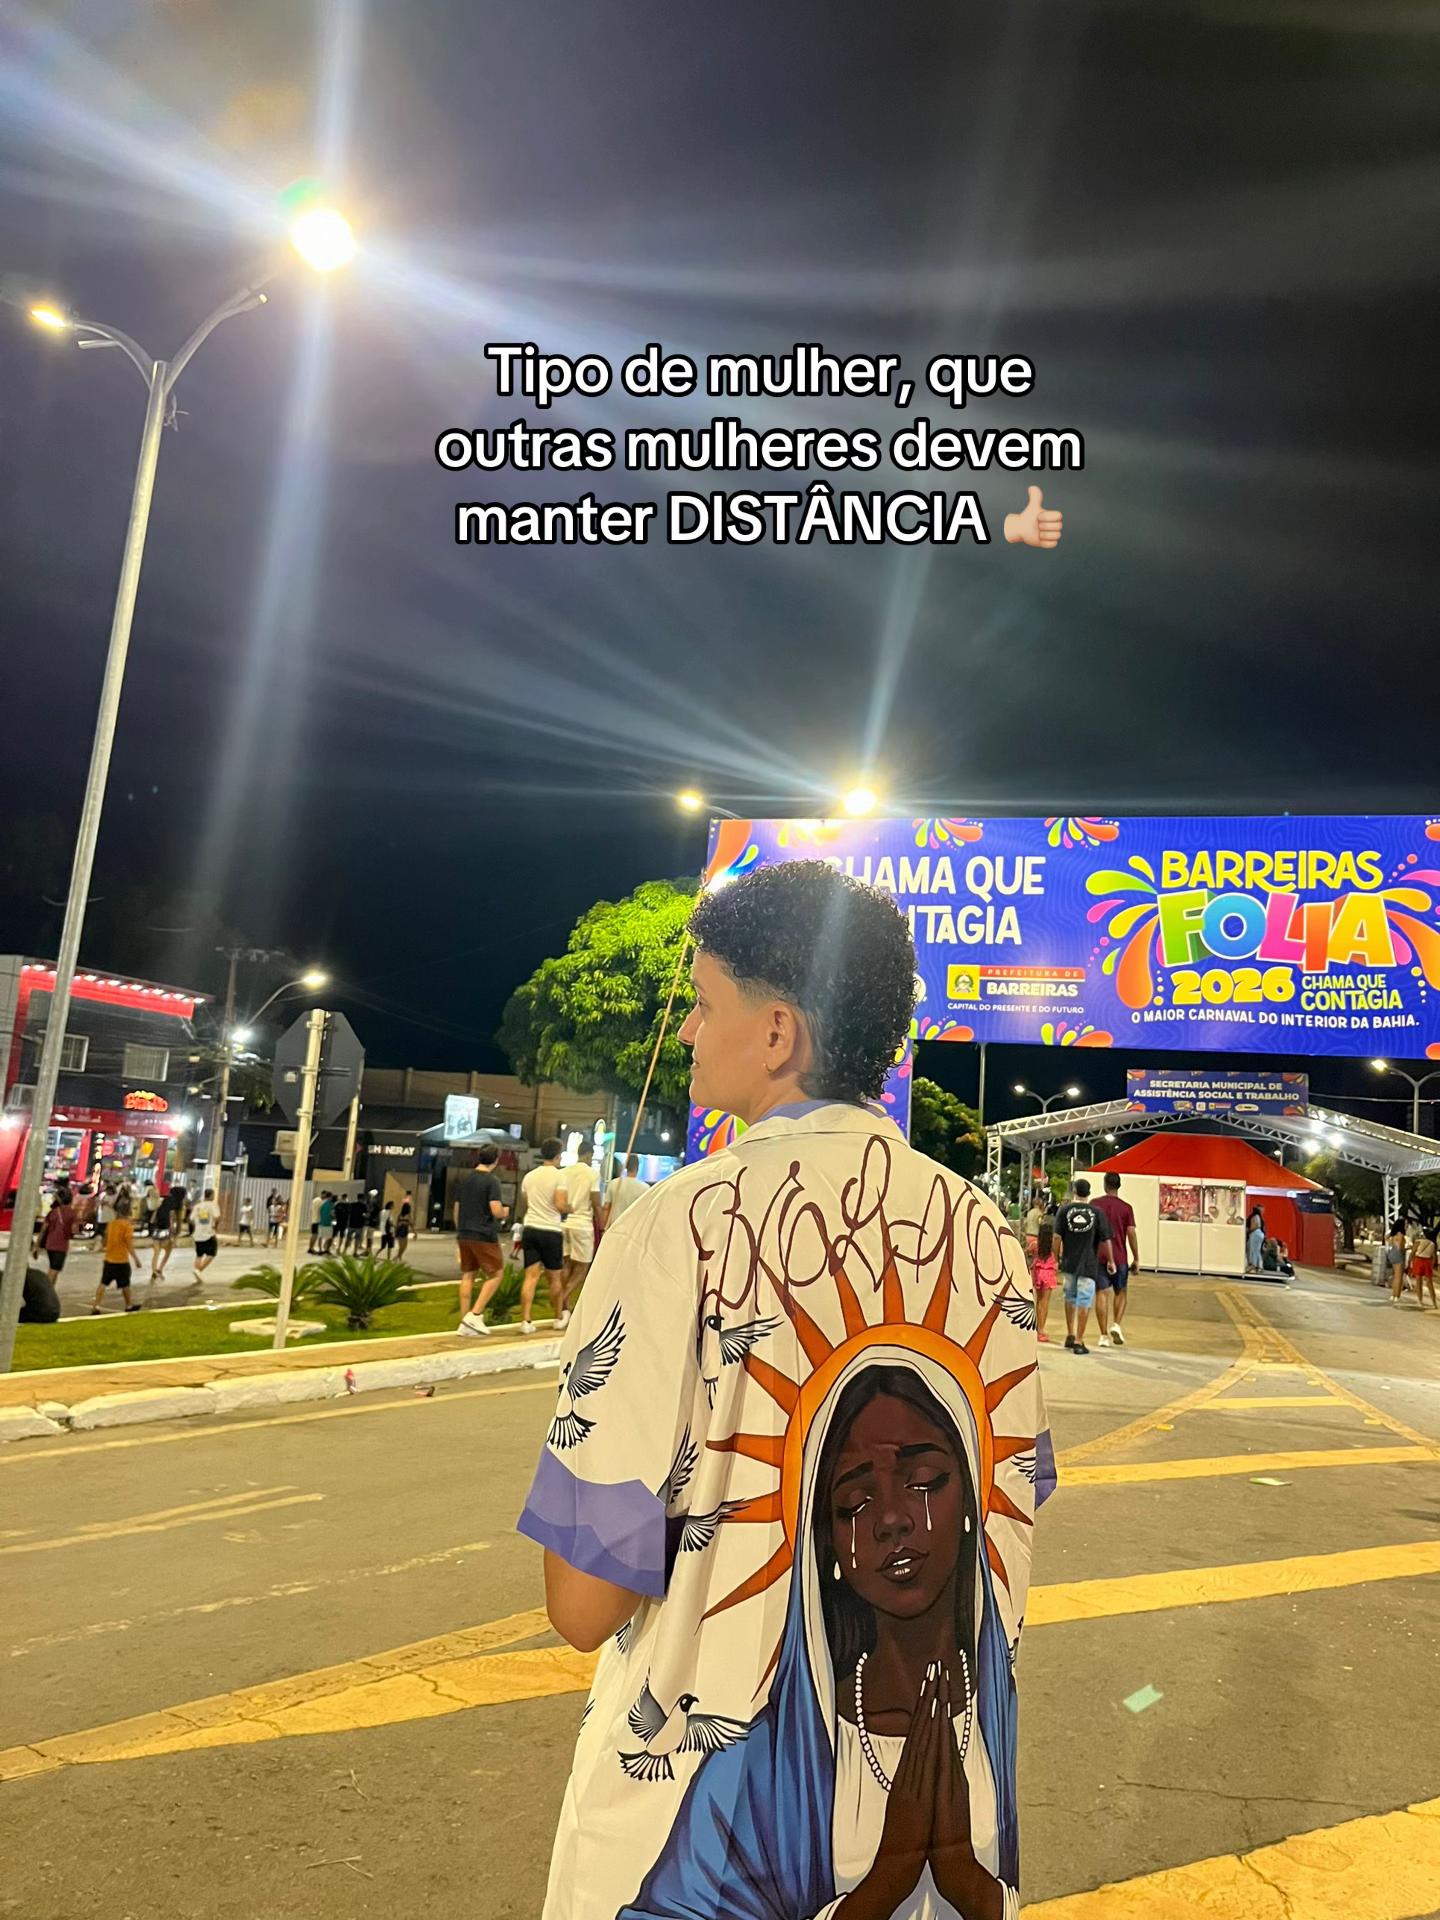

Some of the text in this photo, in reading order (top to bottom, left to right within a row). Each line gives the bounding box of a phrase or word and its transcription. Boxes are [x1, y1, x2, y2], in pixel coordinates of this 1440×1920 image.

[964, 855, 1047, 904] QUE
[1161, 849, 1385, 894] BARREIRAS
[1157, 887, 1398, 974] FOLIA
[987, 968, 1079, 978] PREFEITURA DE
[1301, 973, 1387, 991] CHAMA QUE
[986, 981, 1079, 997] BARREIRAS
[1170, 966, 1296, 1005] 2026
[947, 1002, 1085, 1014] CAPITAL DO PRESENTE E DO FUTURO
[1300, 988, 1404, 1012] CONTAGIA
[1131, 1008, 1420, 1029] O MAIOR CARNAVAL DO INTERIOR DA BAHIA.
[1133, 1088, 1300, 1101] ASSISTÊNCIA SOCIAL E TRABALHO
[1149, 1080, 1283, 1091] SECRETARIA MUNICIPAL DE
